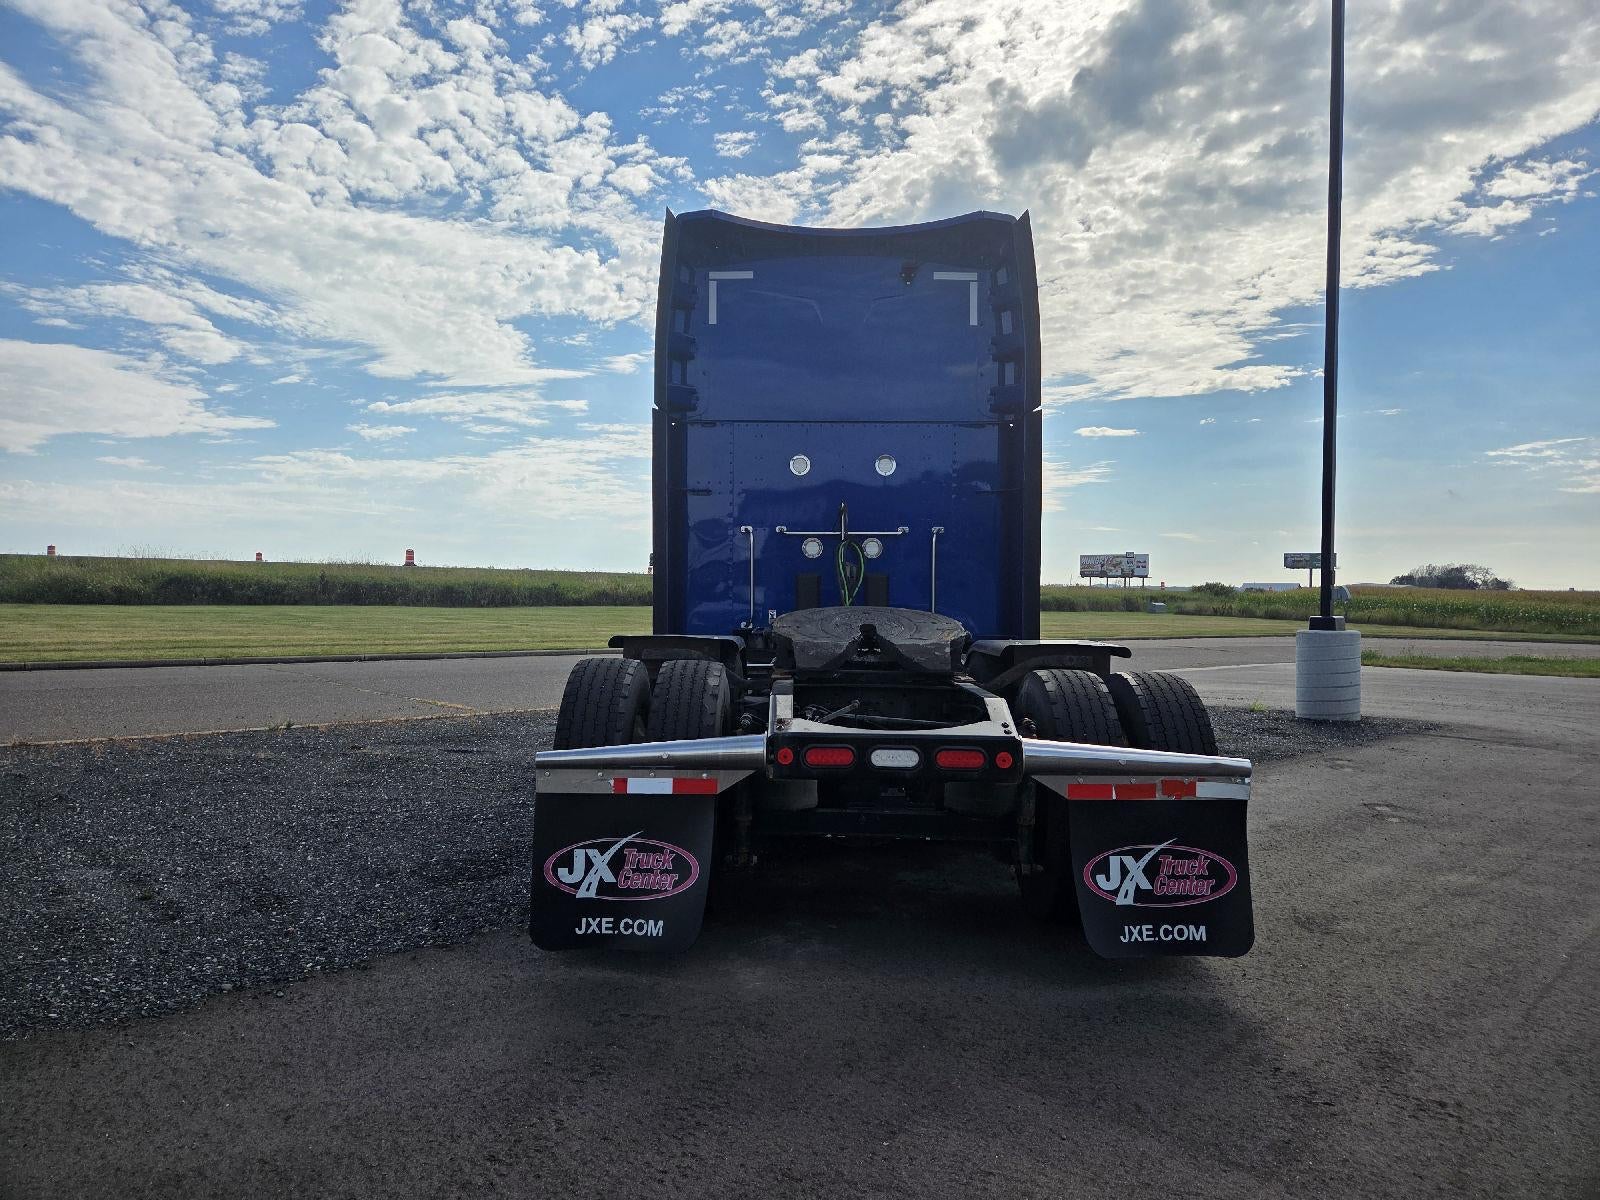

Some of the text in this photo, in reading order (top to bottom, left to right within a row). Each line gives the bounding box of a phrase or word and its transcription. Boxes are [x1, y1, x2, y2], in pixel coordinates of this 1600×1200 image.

[623, 848, 676, 870] Truck
[1158, 855, 1211, 876] Truck
[617, 868, 679, 890] Center
[1153, 874, 1215, 896] Center
[574, 917, 664, 937] JXE.COM
[1119, 924, 1207, 943] JXE.COM
